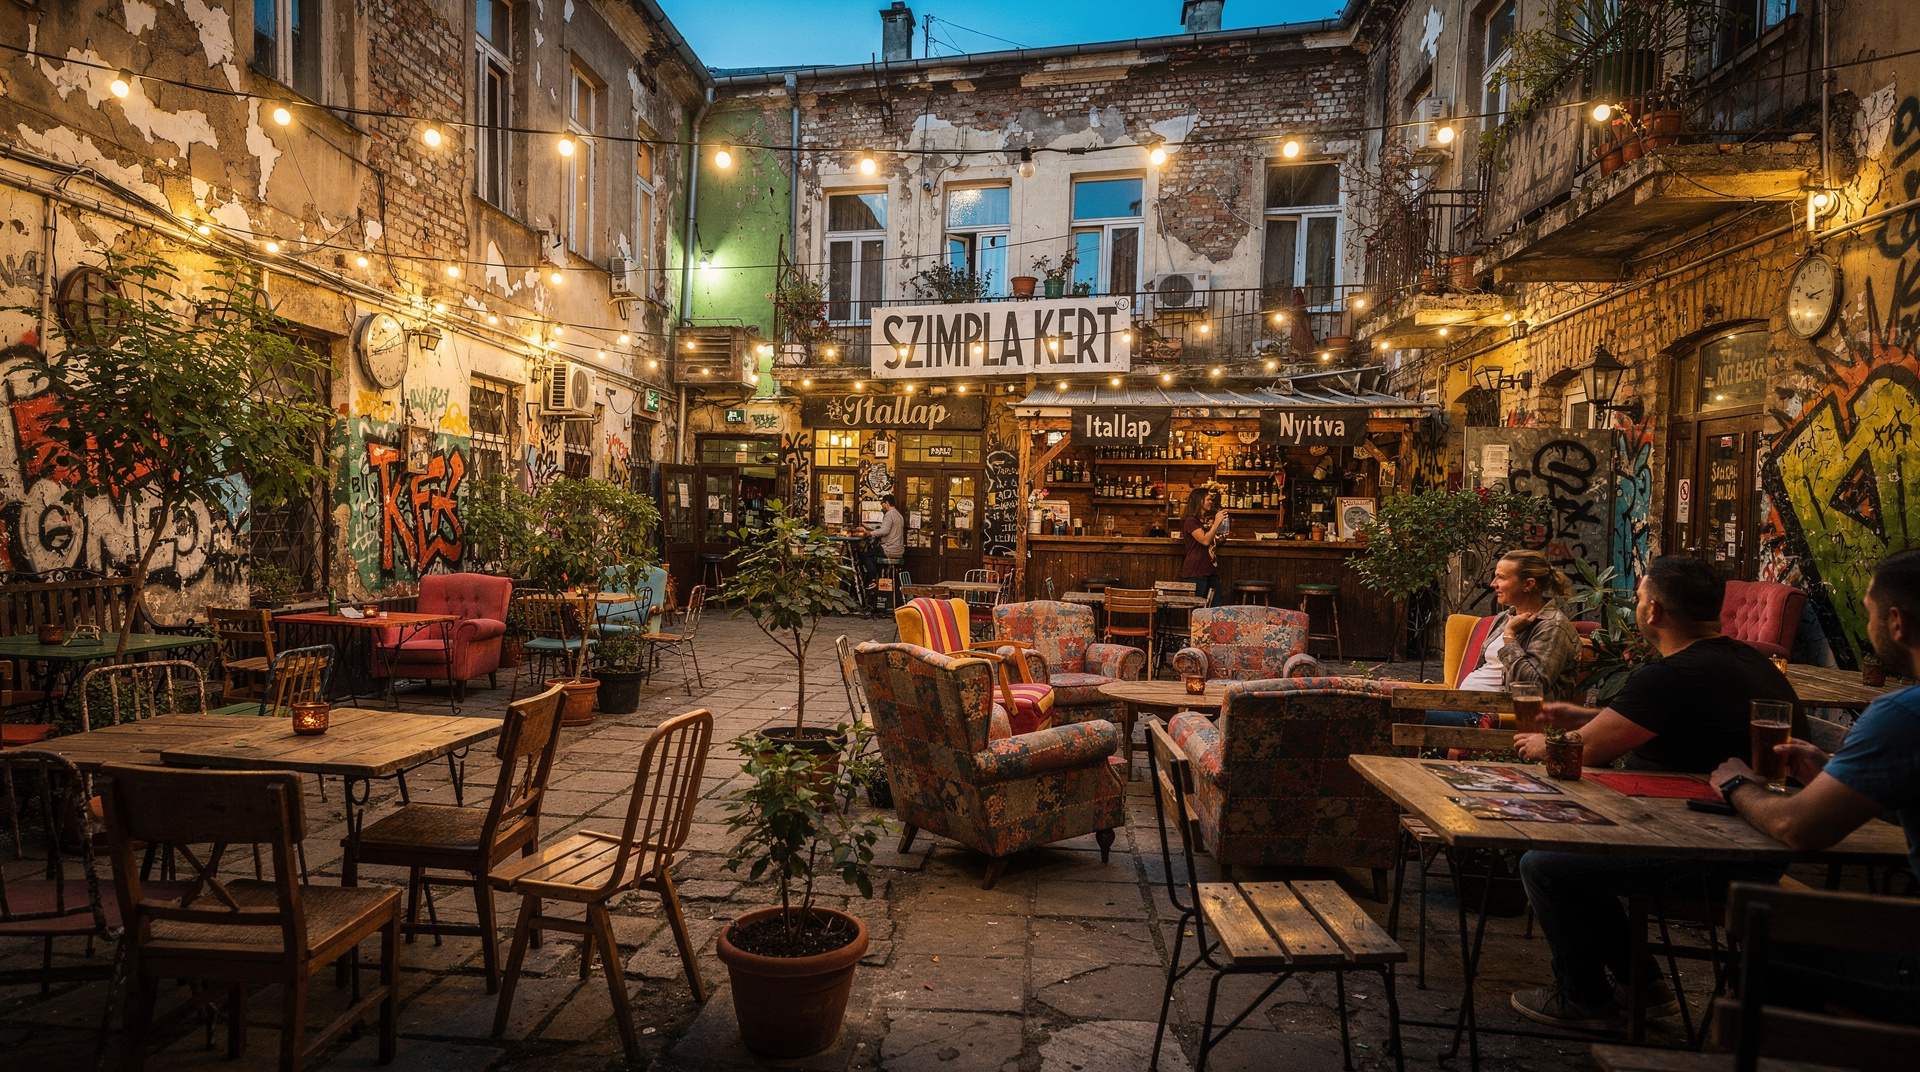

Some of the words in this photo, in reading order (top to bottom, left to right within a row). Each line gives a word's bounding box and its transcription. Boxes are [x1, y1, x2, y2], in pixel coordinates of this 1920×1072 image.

[883, 310, 1024, 370] SZIMPLA
[1034, 306, 1118, 365] KERT
[1086, 413, 1151, 445] Itallap
[1279, 412, 1345, 445] Nyitva
